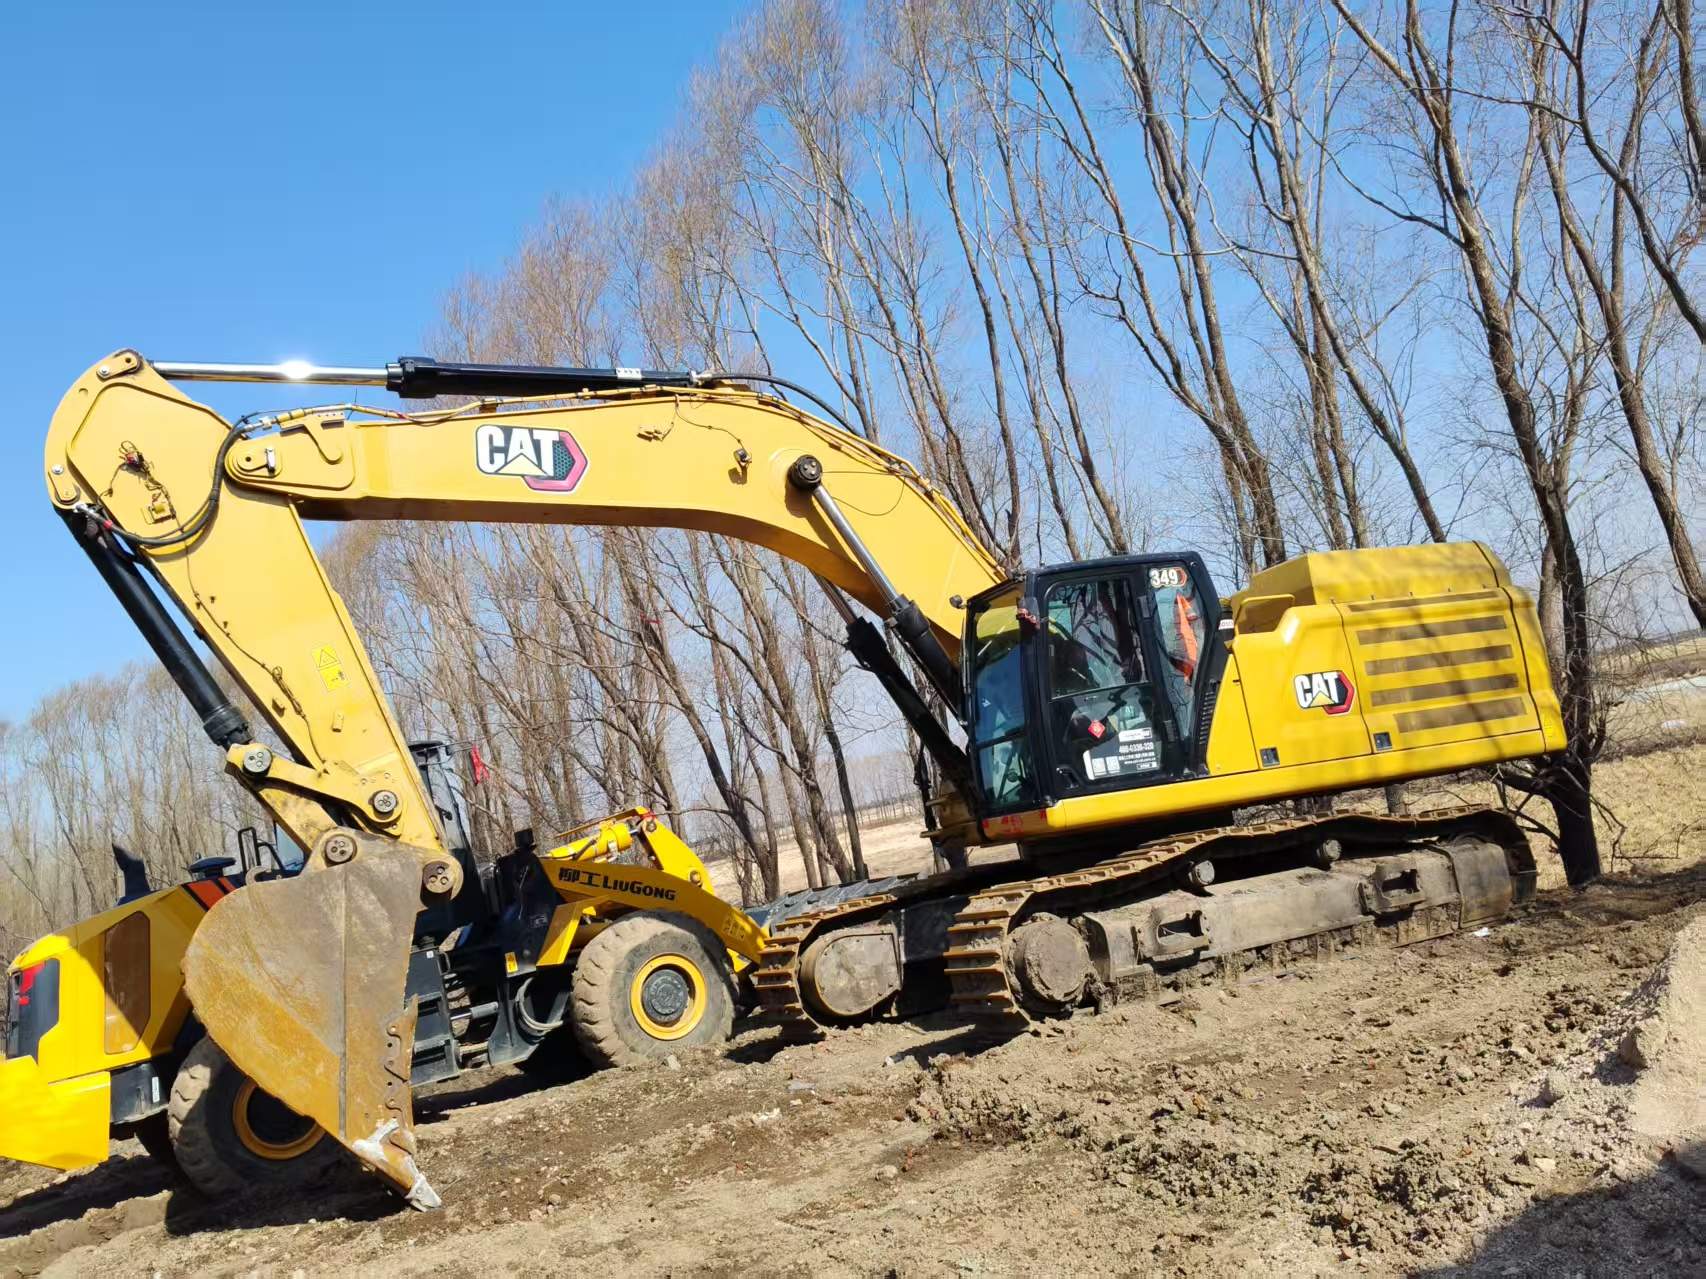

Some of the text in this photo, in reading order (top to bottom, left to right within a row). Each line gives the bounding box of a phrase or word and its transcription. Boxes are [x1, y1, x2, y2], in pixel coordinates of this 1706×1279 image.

[477, 425, 560, 477] CAT
[1151, 567, 1179, 587] 349
[1294, 671, 1340, 708] CAT
